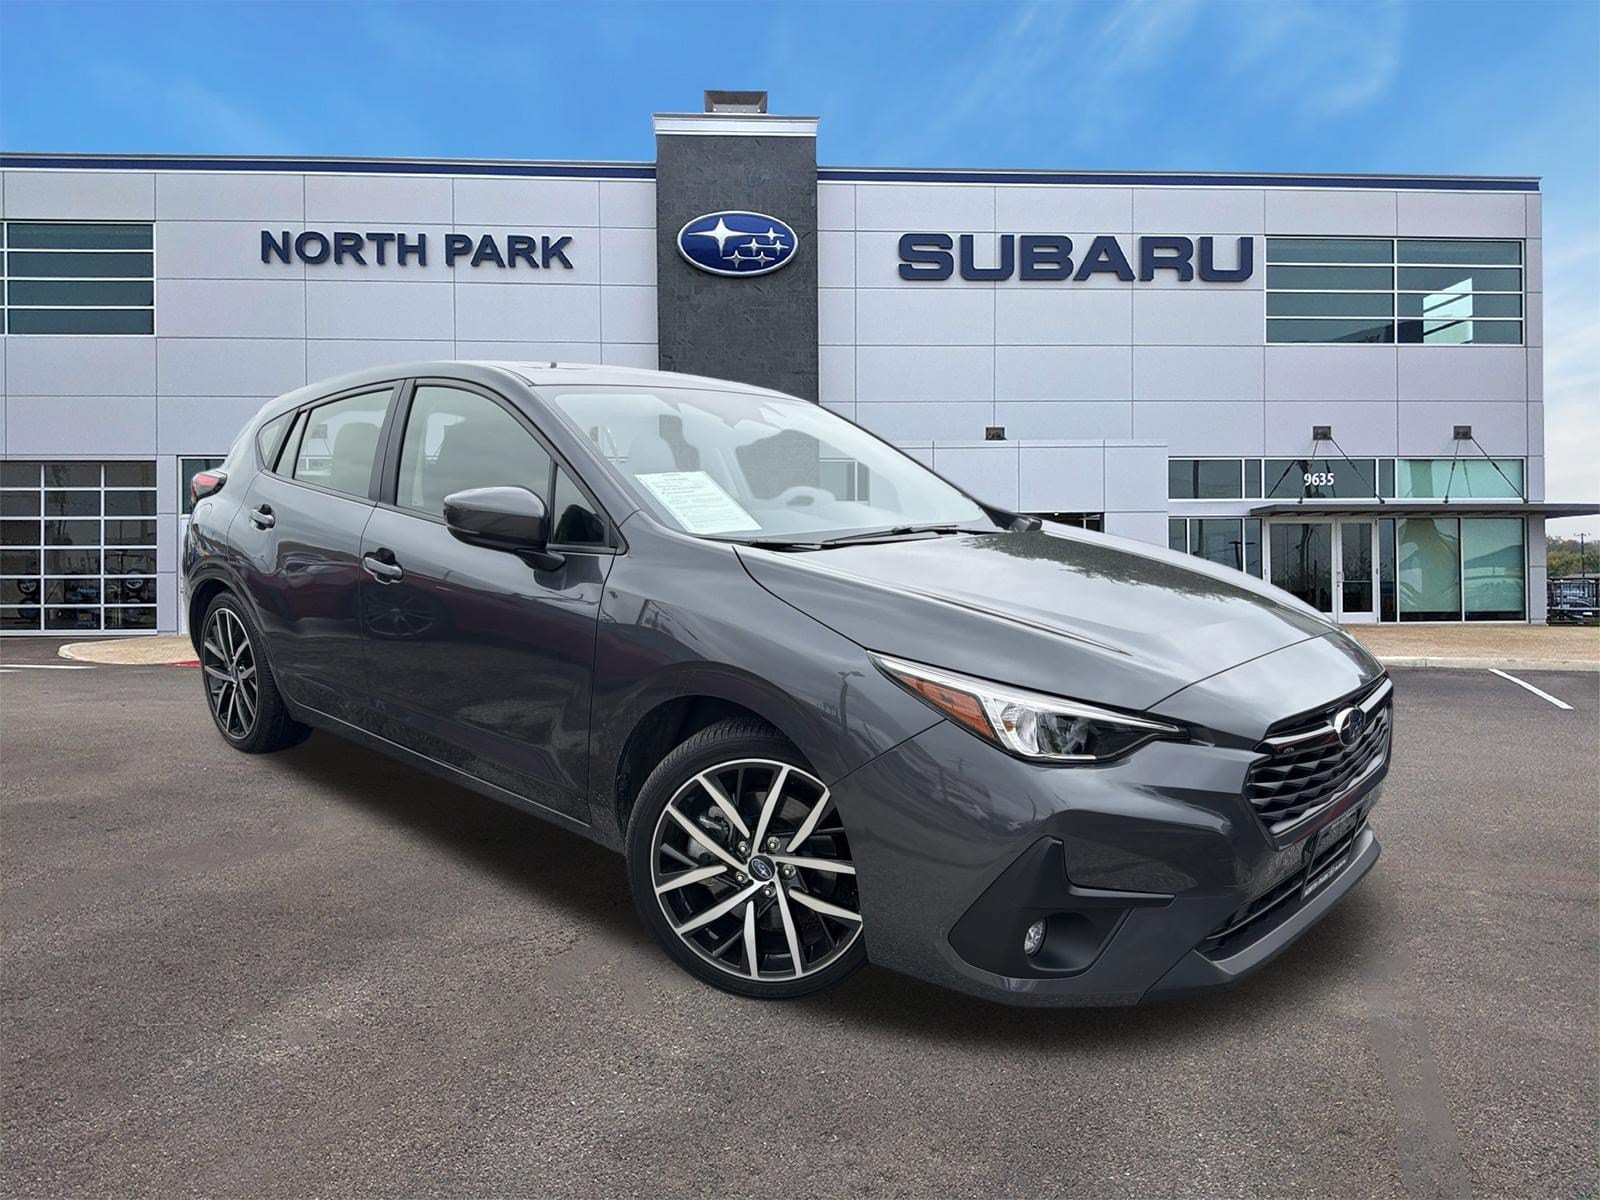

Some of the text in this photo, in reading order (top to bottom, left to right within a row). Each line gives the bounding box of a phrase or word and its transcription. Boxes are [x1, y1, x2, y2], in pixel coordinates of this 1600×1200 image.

[260, 230, 574, 269] NORTH PARK
[898, 233, 1254, 282] SUBARU
[1303, 472, 1335, 486] 9635
